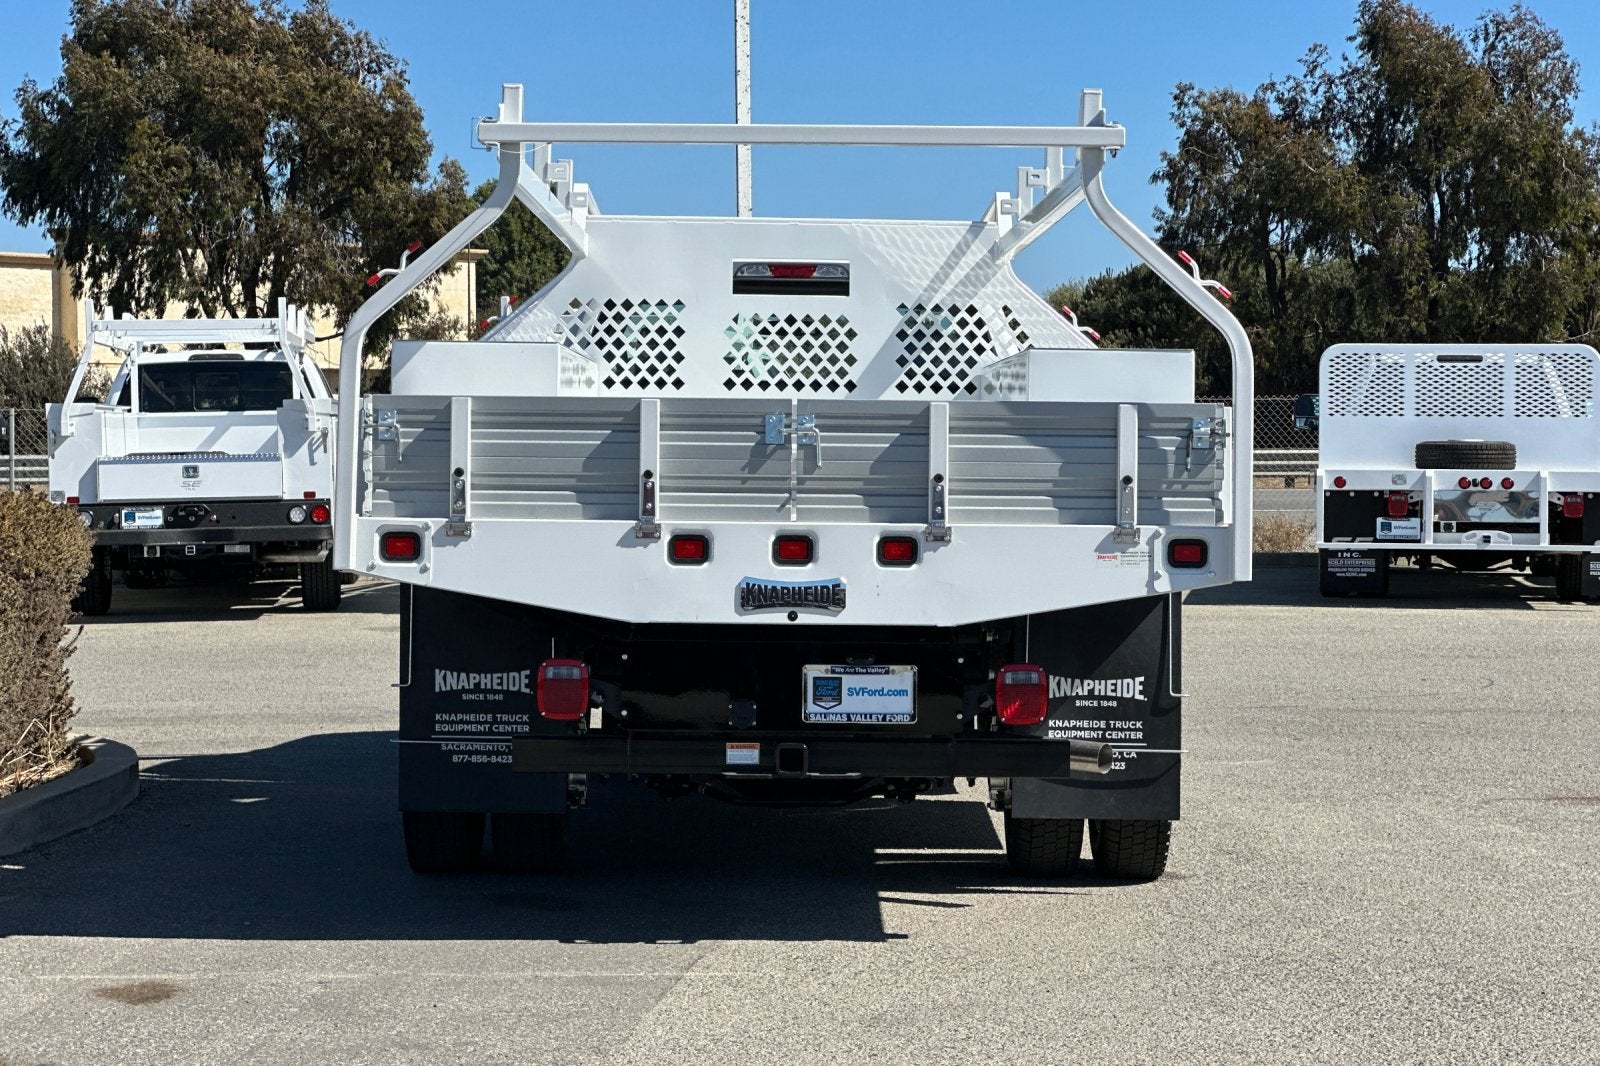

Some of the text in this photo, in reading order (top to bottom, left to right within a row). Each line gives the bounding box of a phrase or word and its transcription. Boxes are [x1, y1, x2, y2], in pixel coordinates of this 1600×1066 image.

[746, 582, 841, 606] KNAPHEIDE
[846, 687, 909, 697] SVFord.com
[435, 713, 530, 722] KNAPHEIDE TRUCK
[810, 713, 848, 721] SALINAS
[886, 714, 910, 722] FORD
[435, 724, 530, 732] EQUIPMENT CENTER
[1048, 720, 1143, 729] KNAPHEIDE TRUCK
[1048, 730, 1143, 739] EQUIPMENT CENTER
[441, 743, 509, 753] SACRAMENTO,
[452, 755, 512, 763] 877-856-8423
